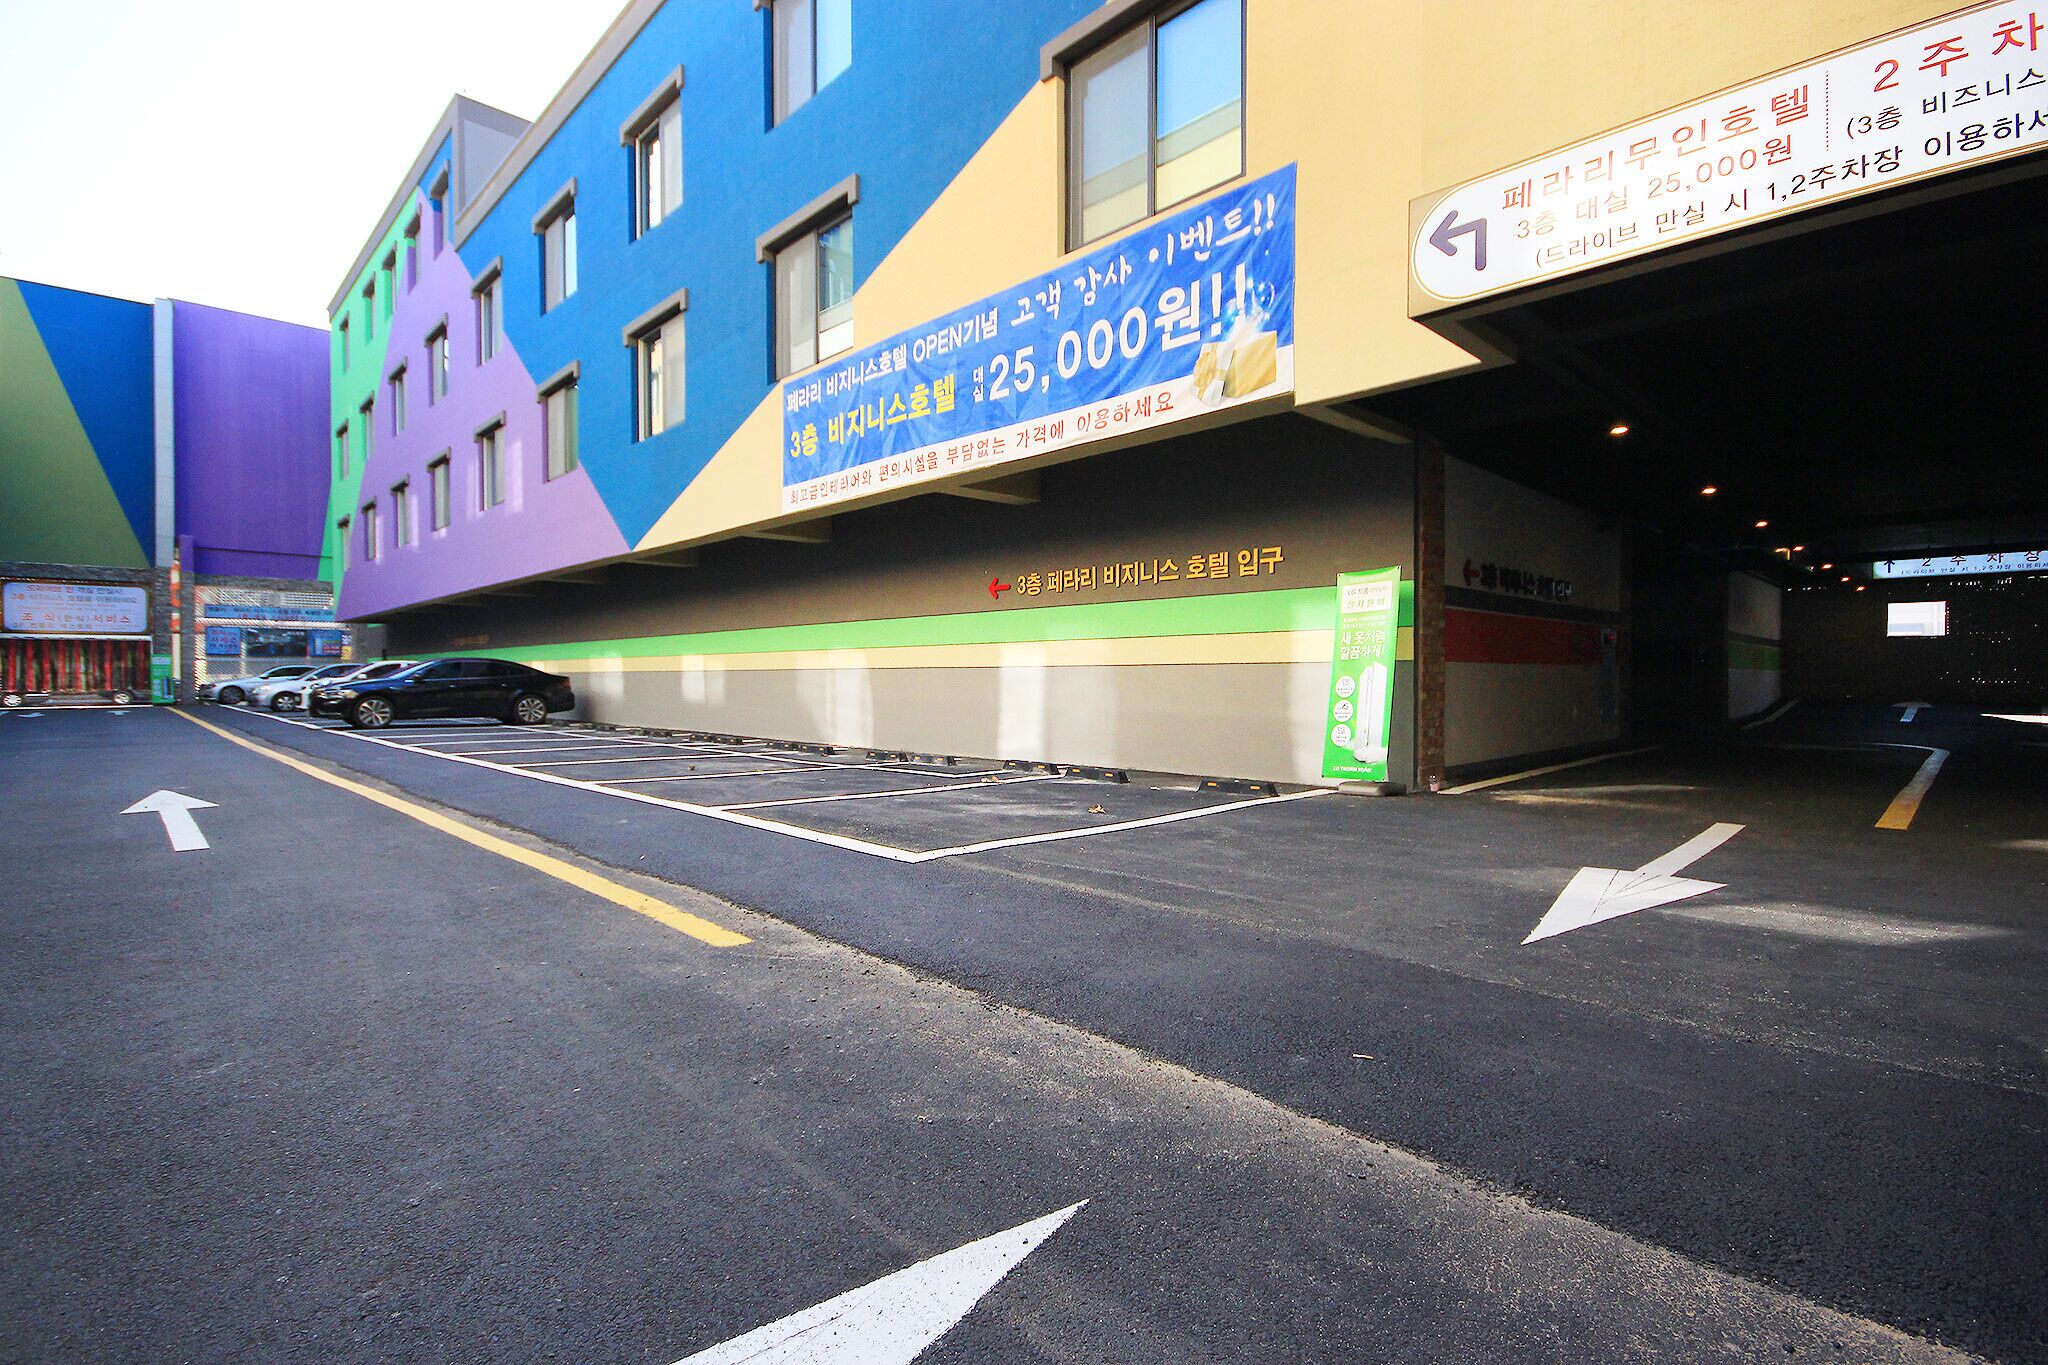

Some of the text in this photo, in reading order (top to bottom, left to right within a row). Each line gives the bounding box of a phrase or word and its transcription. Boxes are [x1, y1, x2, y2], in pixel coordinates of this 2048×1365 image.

[1502, 84, 1809, 210] 페라리무인호텔
[1846, 68, 2047, 139] (3층 비즈니스
[1517, 134, 1792, 239] 3층 대실 25,000원
[1536, 222, 1639, 268] (드라이브
[1656, 200, 1705, 234] 만실
[1725, 189, 1748, 212] 시
[1767, 145, 1903, 201] 1,2주차장
[787, 193, 1275, 412] 페라리 비지니스호텔 OPEN기념 고객 감사 이벤트!!
[790, 423, 818, 457] 3층
[828, 373, 956, 445] 비지니스호텔
[973, 365, 984, 403] 대실
[879, 451, 937, 482] 편의시설을
[947, 436, 1006, 464] 부담없는
[1016, 420, 1064, 448] 가격에
[1077, 391, 1174, 431] 이용하세요
[1016, 546, 1285, 596] 3층 페라리 비지니스 호텔 입구
